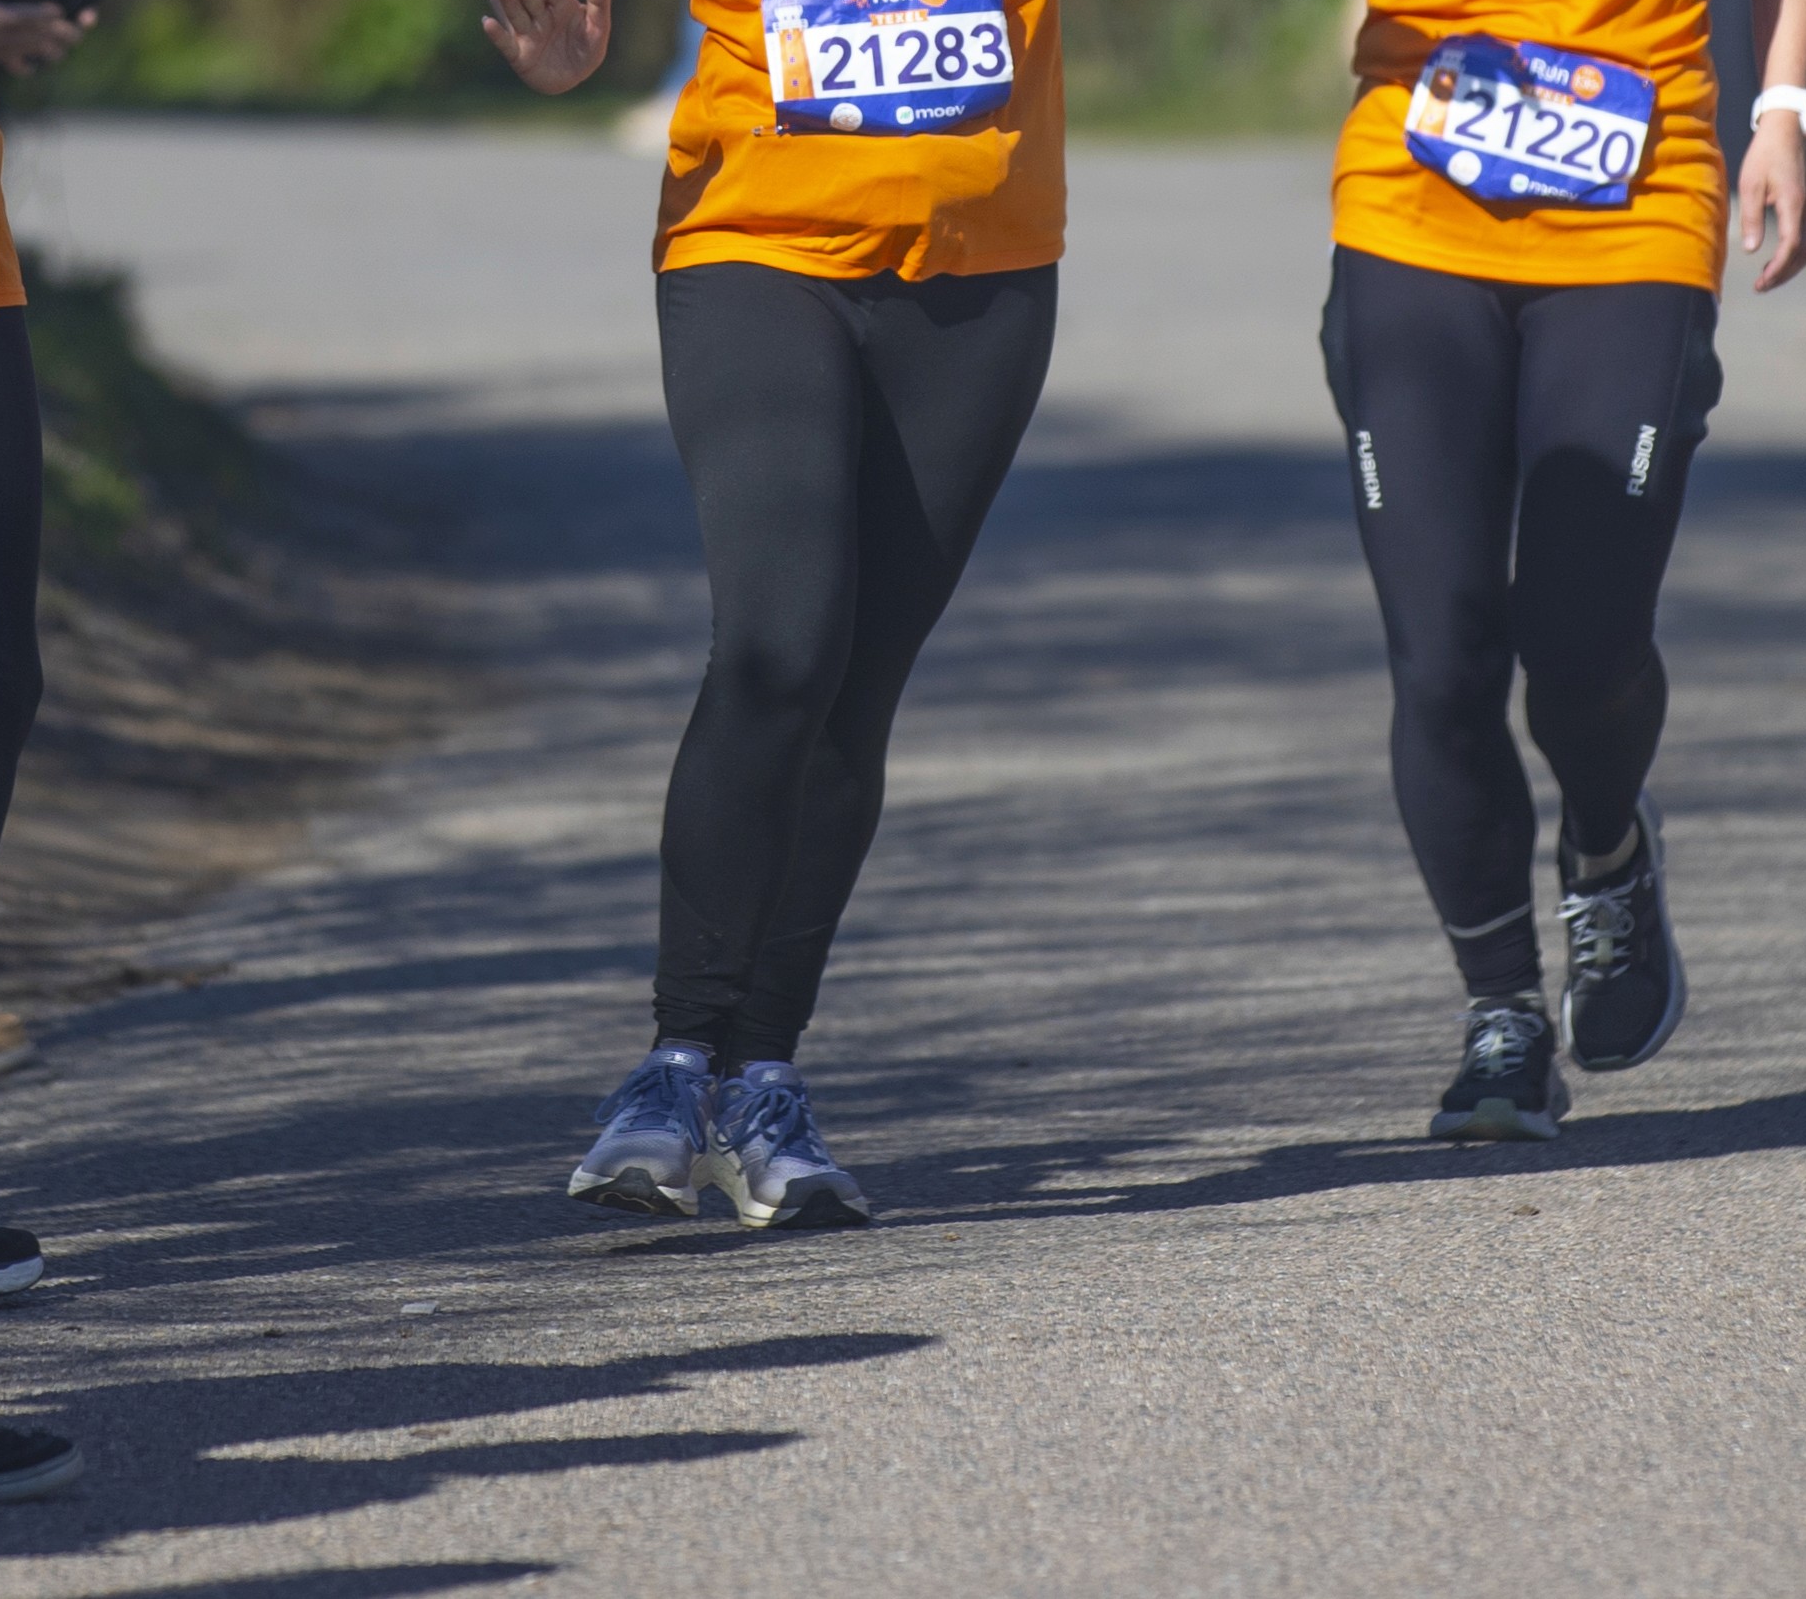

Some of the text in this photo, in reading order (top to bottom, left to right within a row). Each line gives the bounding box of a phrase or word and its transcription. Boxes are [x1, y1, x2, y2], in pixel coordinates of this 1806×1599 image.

[877, 10, 924, 25] TEXEL
[819, 23, 1007, 91] 21283
[1529, 57, 1570, 87] Run
[915, 105, 966, 119] moev
[1454, 89, 1635, 181] 21220
[1355, 430, 1383, 509] FUSION
[1626, 424, 1657, 496] FUSION
